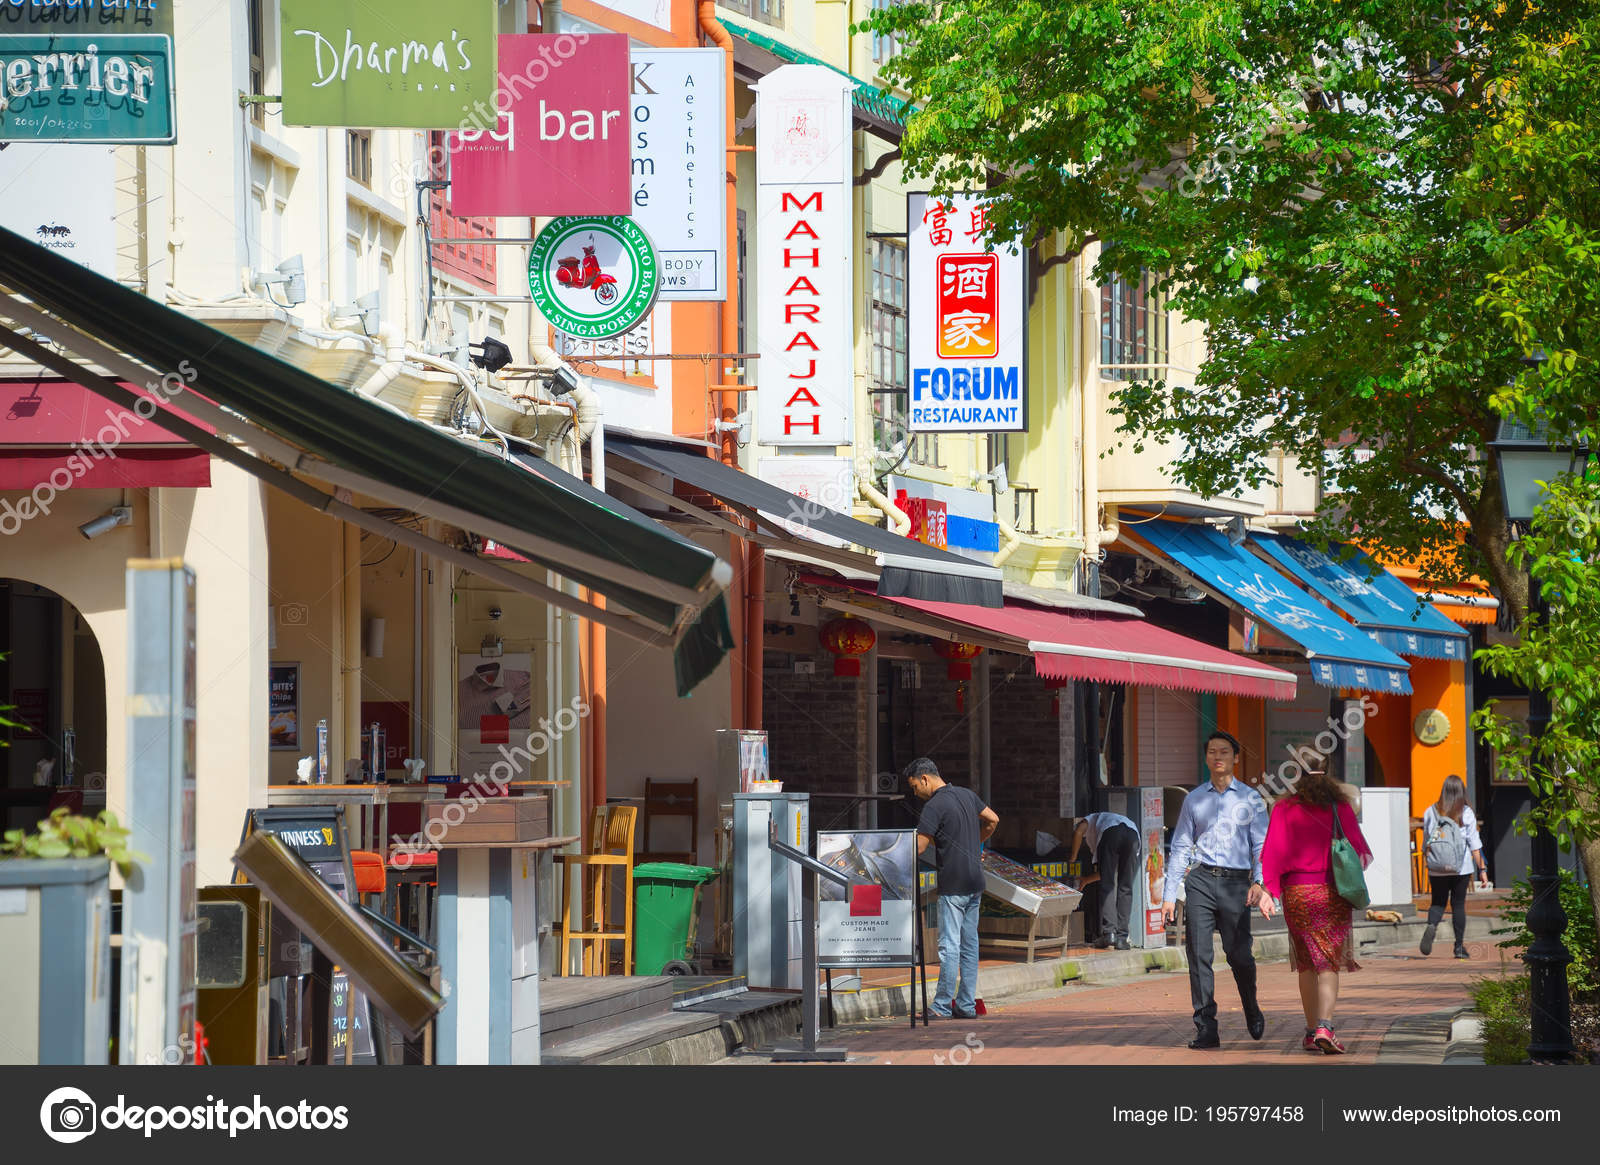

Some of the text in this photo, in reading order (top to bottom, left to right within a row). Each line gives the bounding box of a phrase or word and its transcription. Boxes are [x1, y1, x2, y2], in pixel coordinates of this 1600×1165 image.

[0, 43, 155, 112] errier
[294, 28, 471, 87] Dharma's
[539, 99, 621, 141] bar
[631, 62, 660, 207] Kosmé
[685, 75, 695, 238] Aesthetics
[530, 234, 551, 307] VESPETTA
[612, 216, 652, 266] GASTRO
[638, 270, 653, 300] BAR
[665, 259, 703, 269] BODY
[552, 308, 636, 335] SINGAPORE
[780, 191, 823, 435] MAHARAJAH
[943, 262, 992, 349] 酒家
[913, 366, 1019, 400] FORUM
[913, 407, 1018, 424] RESTAURANT
[334, 1017, 361, 1029] PIZA
